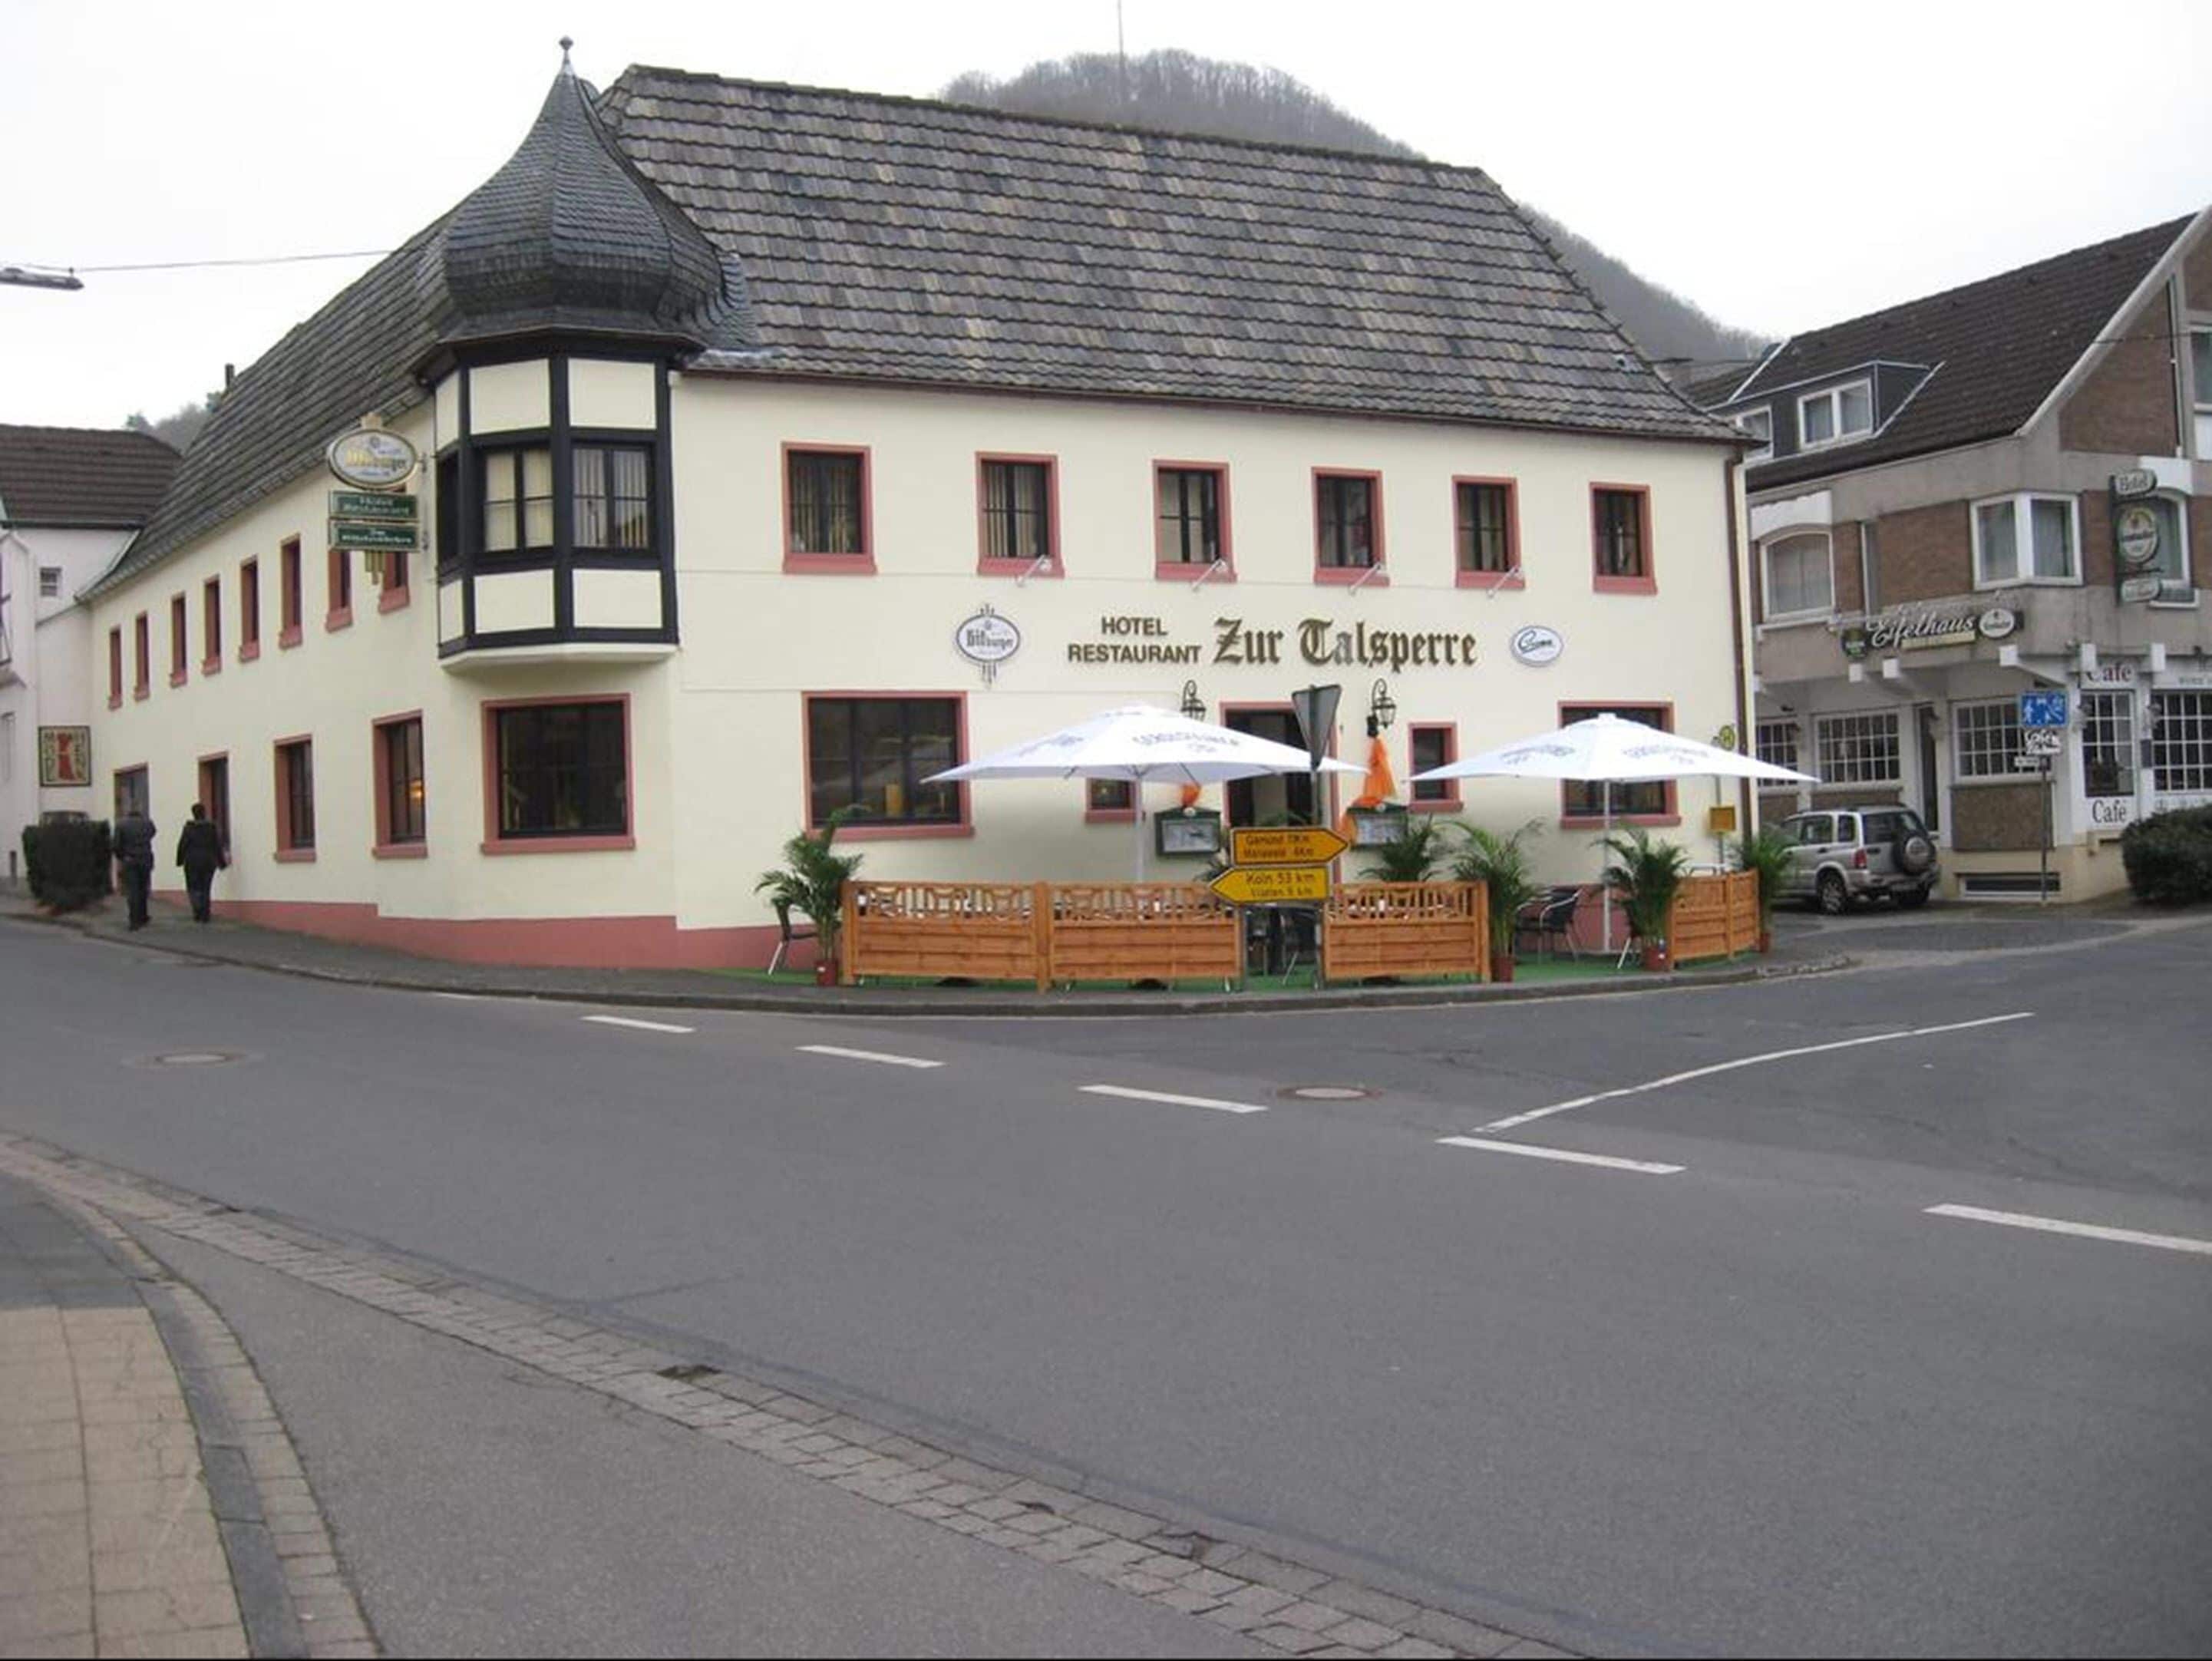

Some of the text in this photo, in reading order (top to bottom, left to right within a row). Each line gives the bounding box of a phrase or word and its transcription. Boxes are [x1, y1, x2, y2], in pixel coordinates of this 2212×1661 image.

[1101, 616, 1168, 636] HOTEL
[1867, 612, 1976, 648] Eifelhaus
[1068, 643, 1203, 664] RESTAURANT
[1213, 616, 1284, 666] Zur
[1297, 618, 1477, 673] Talsperre
